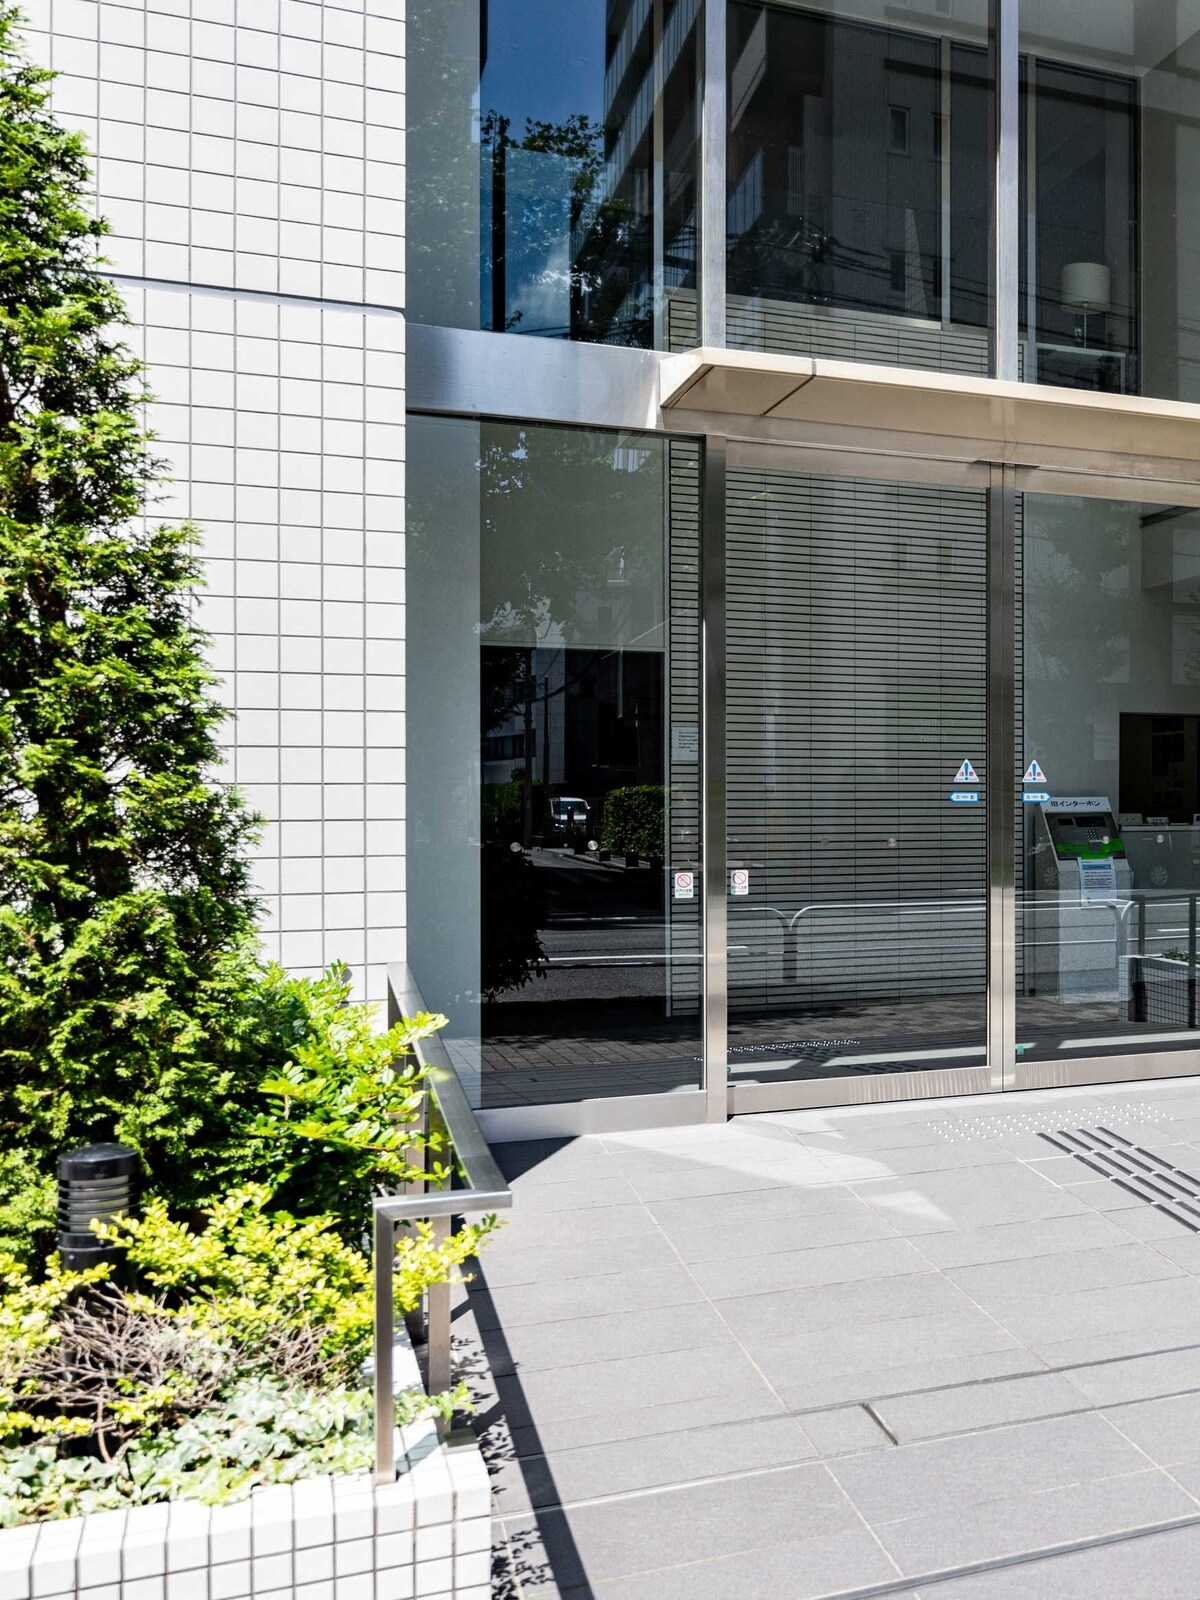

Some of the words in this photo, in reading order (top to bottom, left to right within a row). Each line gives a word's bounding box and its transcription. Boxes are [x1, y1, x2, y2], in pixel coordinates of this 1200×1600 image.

[1050, 800, 1101, 808] 旧インターホン
